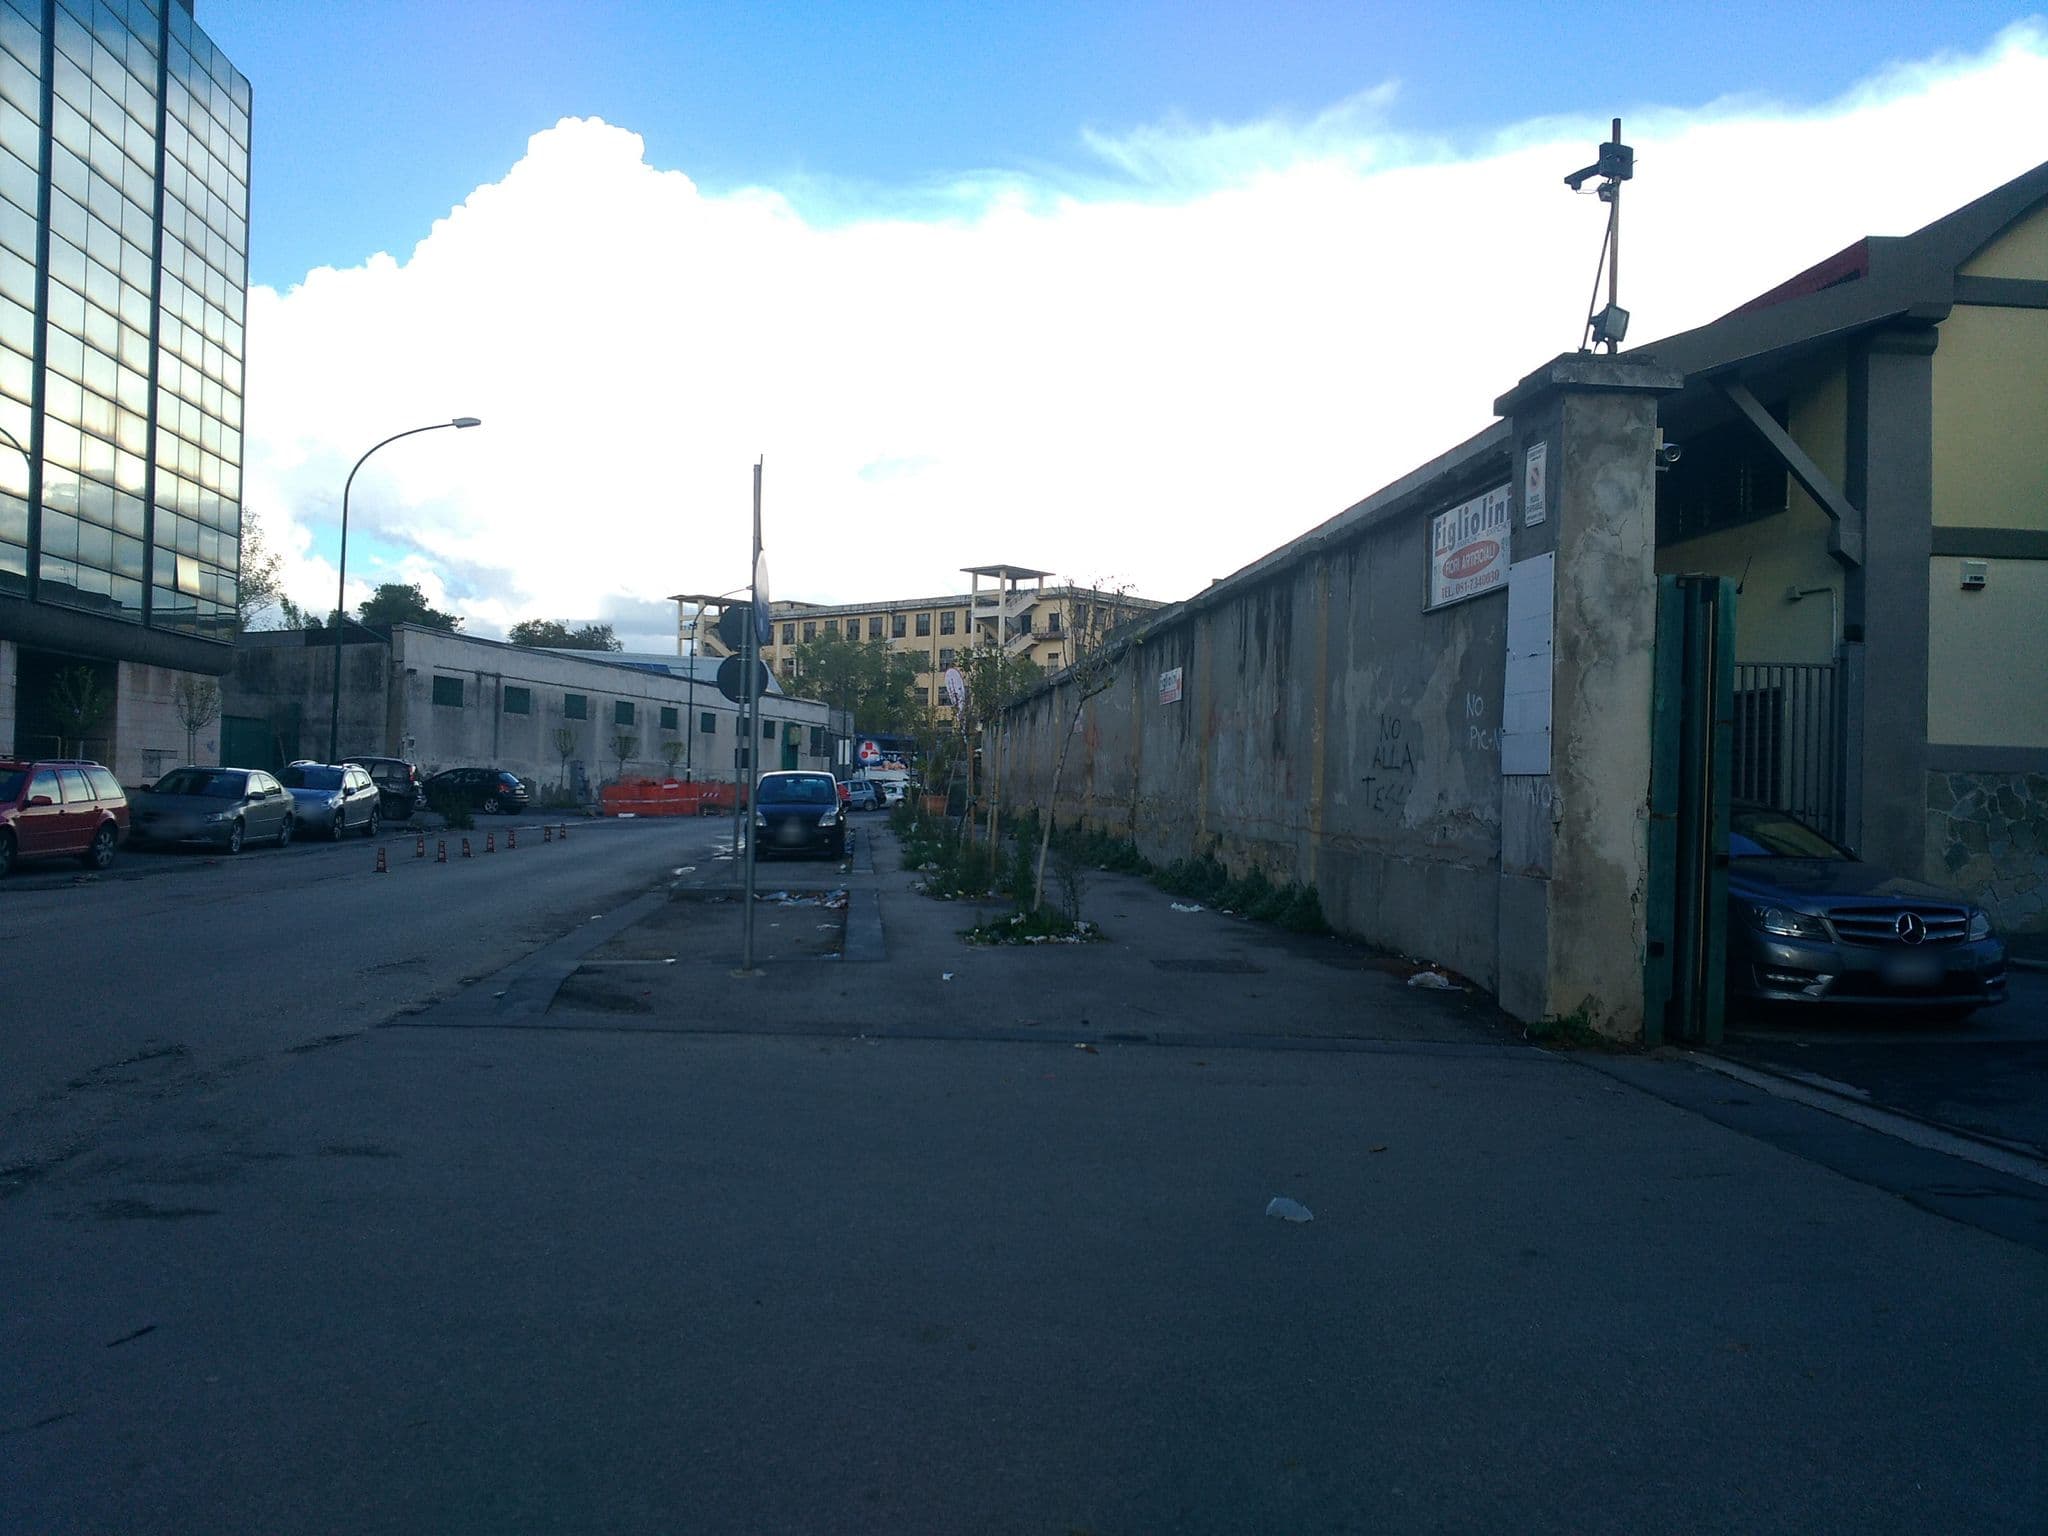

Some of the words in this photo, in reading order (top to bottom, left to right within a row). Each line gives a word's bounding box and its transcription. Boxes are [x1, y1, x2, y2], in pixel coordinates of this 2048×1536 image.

[1466, 692, 1484, 718] NO
[1379, 713, 1401, 742] NO
[1373, 743, 1415, 775] ALLA
